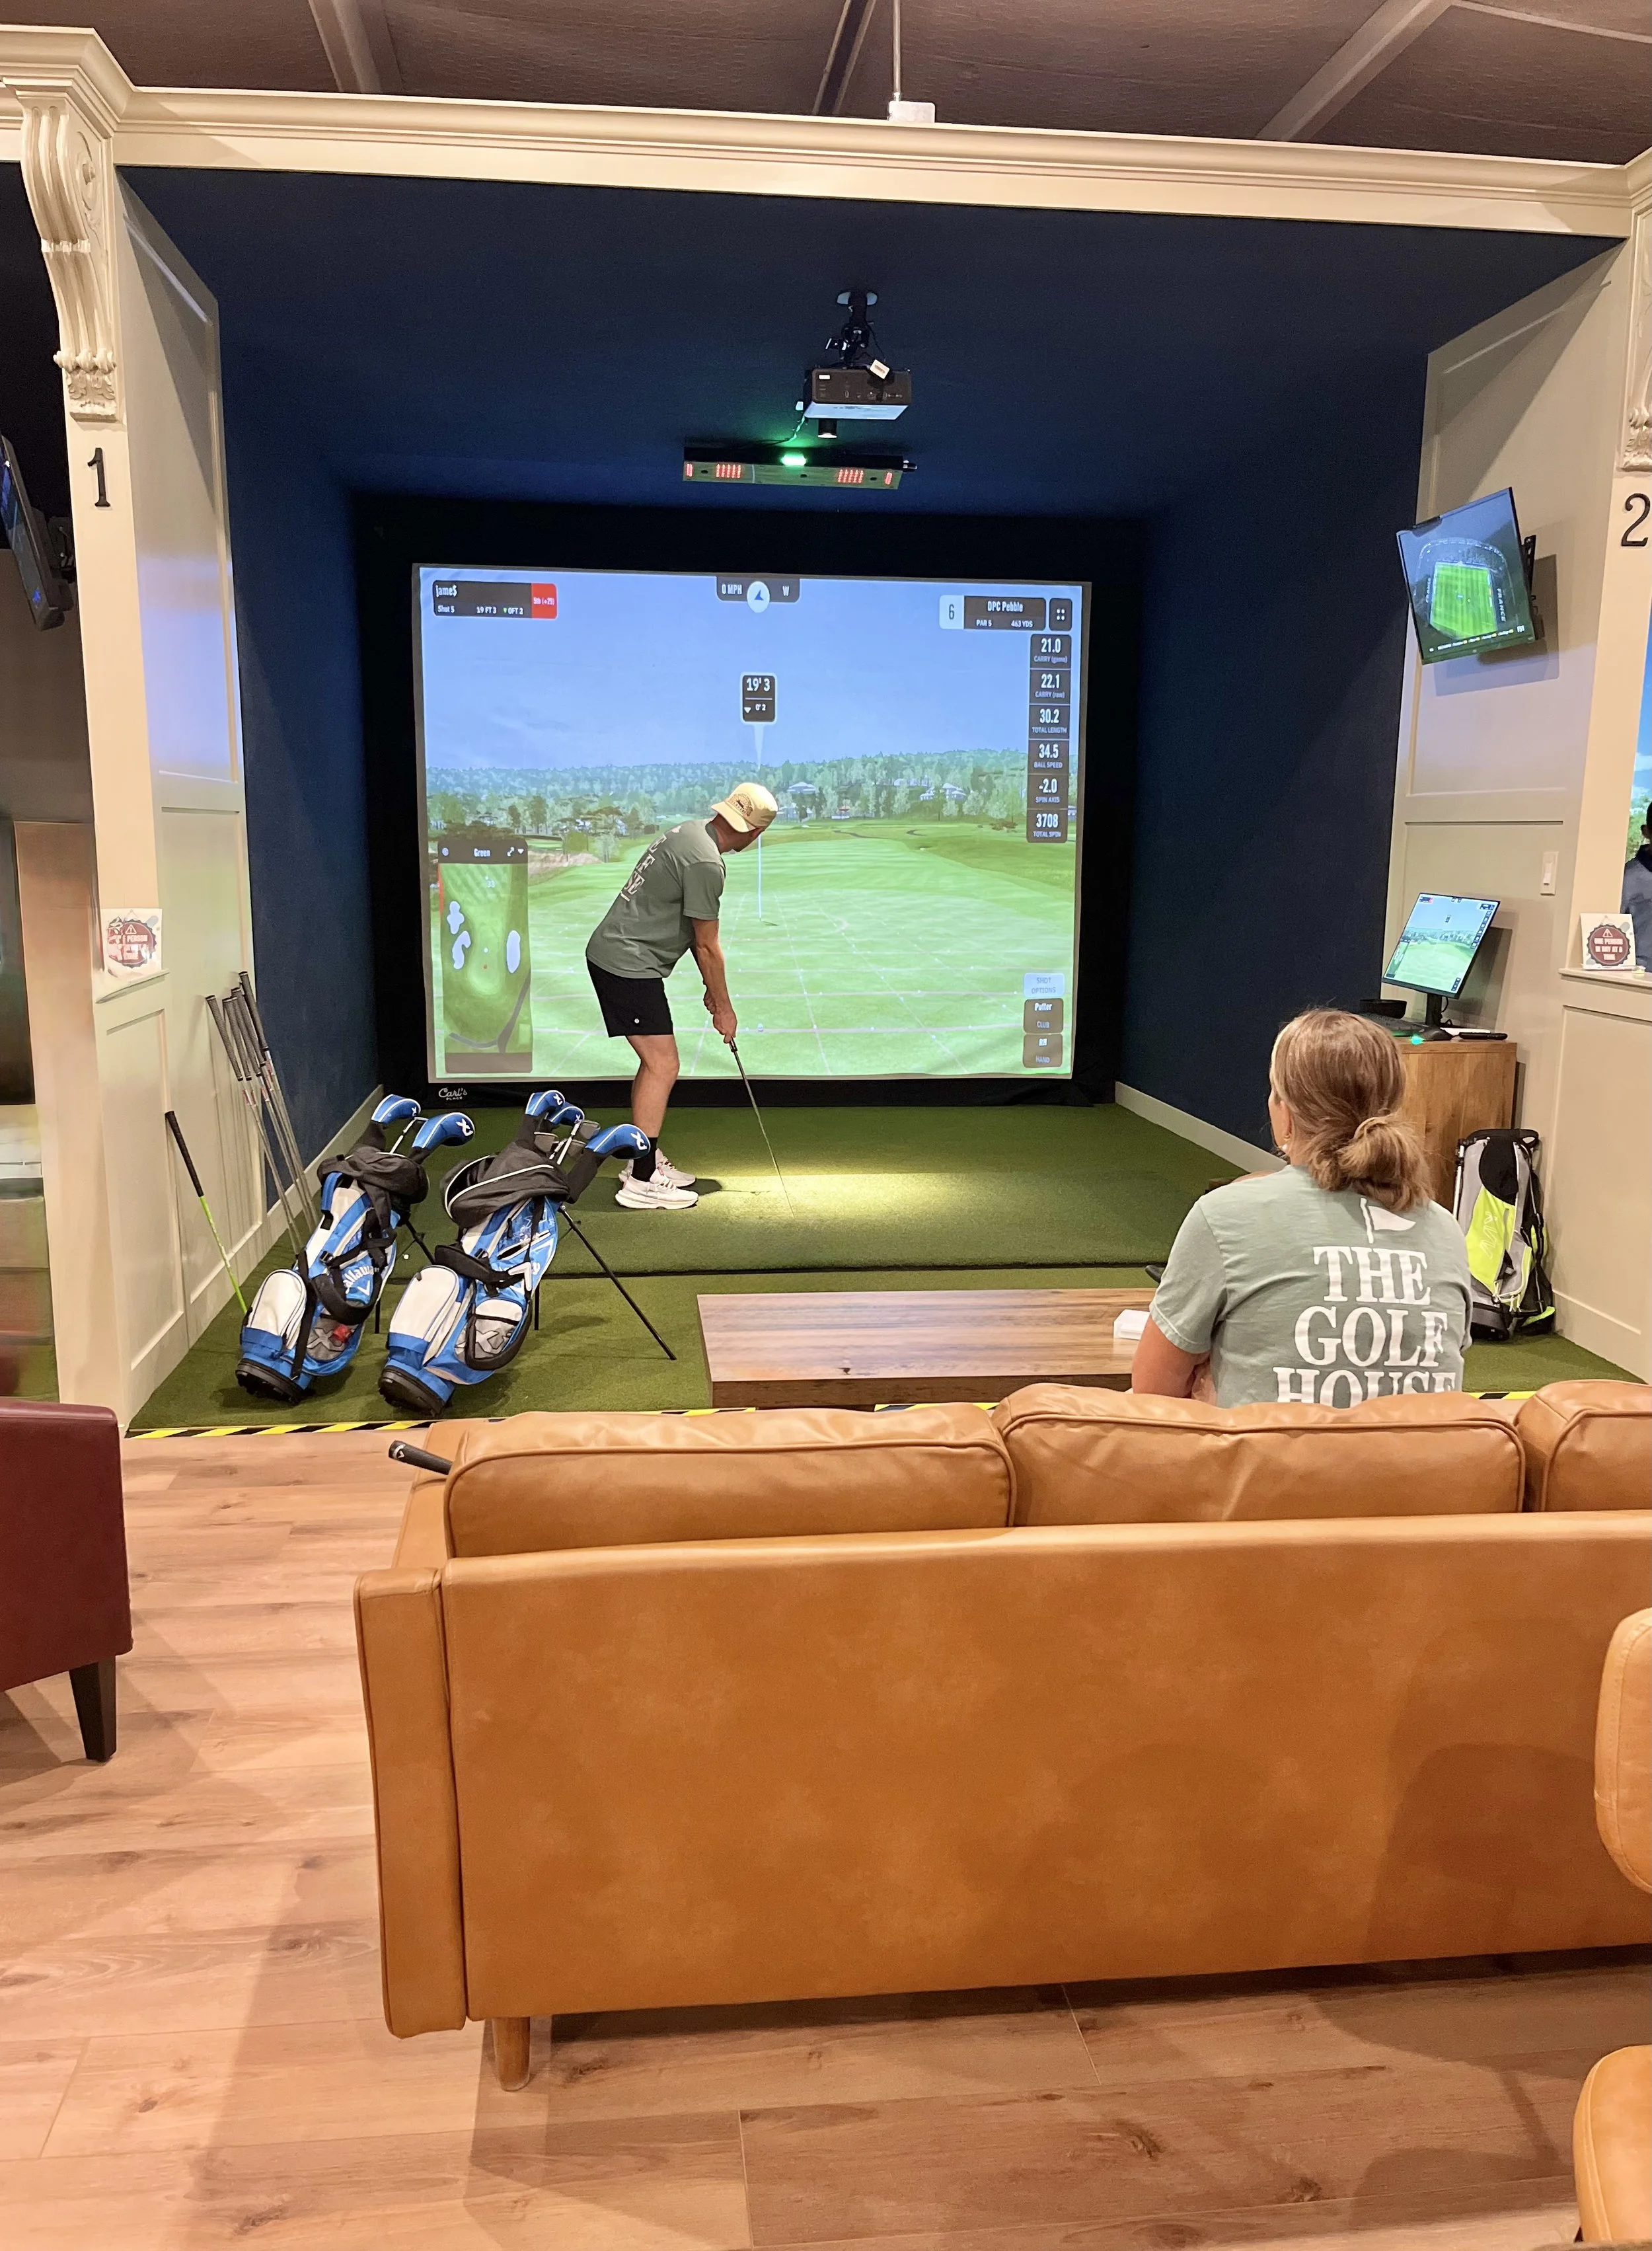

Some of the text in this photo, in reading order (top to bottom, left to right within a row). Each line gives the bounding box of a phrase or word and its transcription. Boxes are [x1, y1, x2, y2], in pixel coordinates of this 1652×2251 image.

[87, 447, 110, 507] 1
[1621, 493, 1651, 547] 2
[722, 584, 742, 595] 0 MPH
[782, 586, 790, 596] W
[948, 604, 955, 620] 6
[987, 601, 1024, 613] DPC Pebble
[1041, 638, 1061, 654] 21.0
[763, 678, 770, 692] 3
[1041, 673, 1060, 689] 22.1
[1039, 708, 1060, 724] 30.2
[1039, 744, 1059, 759] 34.5
[1039, 778, 1057, 794] -2.0
[1036, 813, 1059, 828] 3708
[474, 848, 490, 857] Green
[1035, 1003, 1053, 1011] Putter
[438, 1087, 468, 1098] Carl's
[1312, 1246, 1431, 1305] THE
[1294, 1305, 1448, 1367] GOLF
